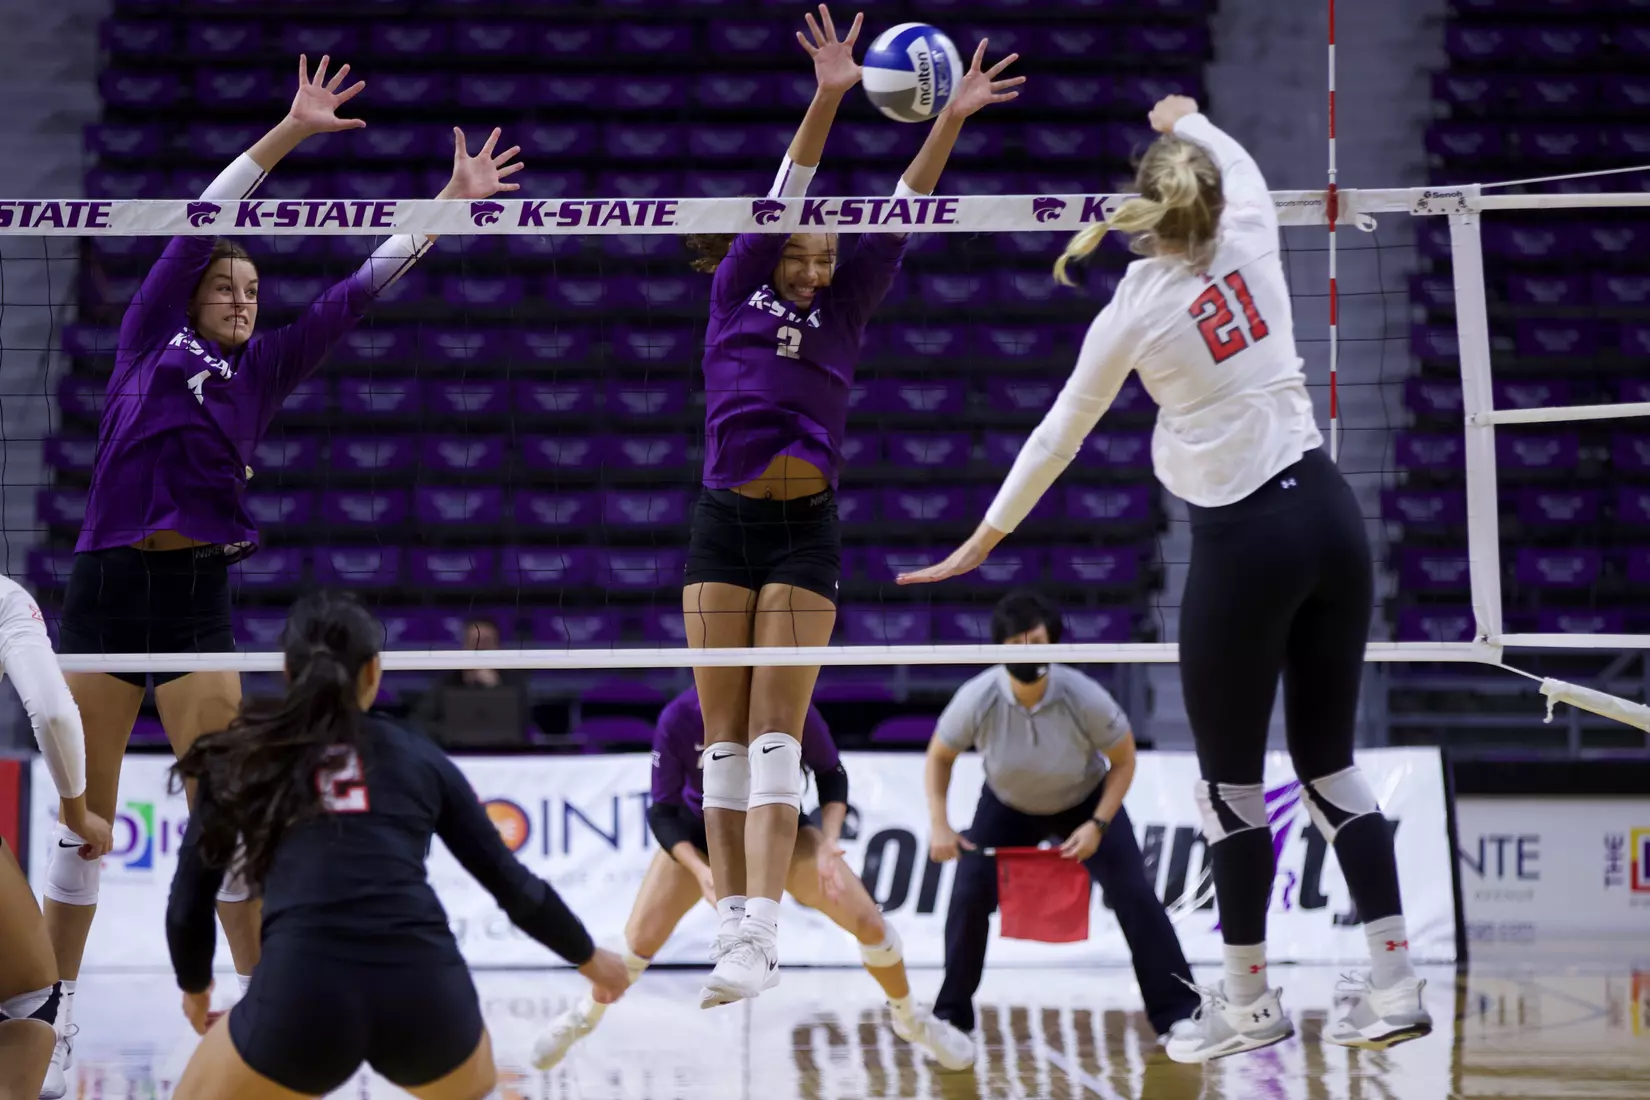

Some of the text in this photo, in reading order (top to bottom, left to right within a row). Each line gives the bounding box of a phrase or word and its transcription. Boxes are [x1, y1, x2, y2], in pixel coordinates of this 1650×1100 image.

[917, 51, 931, 105] molten
[1432, 190, 1463, 199] Senoh
[235, 201, 396, 228] K-STATE
[518, 201, 678, 226] K-STATE
[799, 199, 959, 225] K-STATE
[1188, 269, 1269, 365] 21
[776, 325, 803, 360] 2
